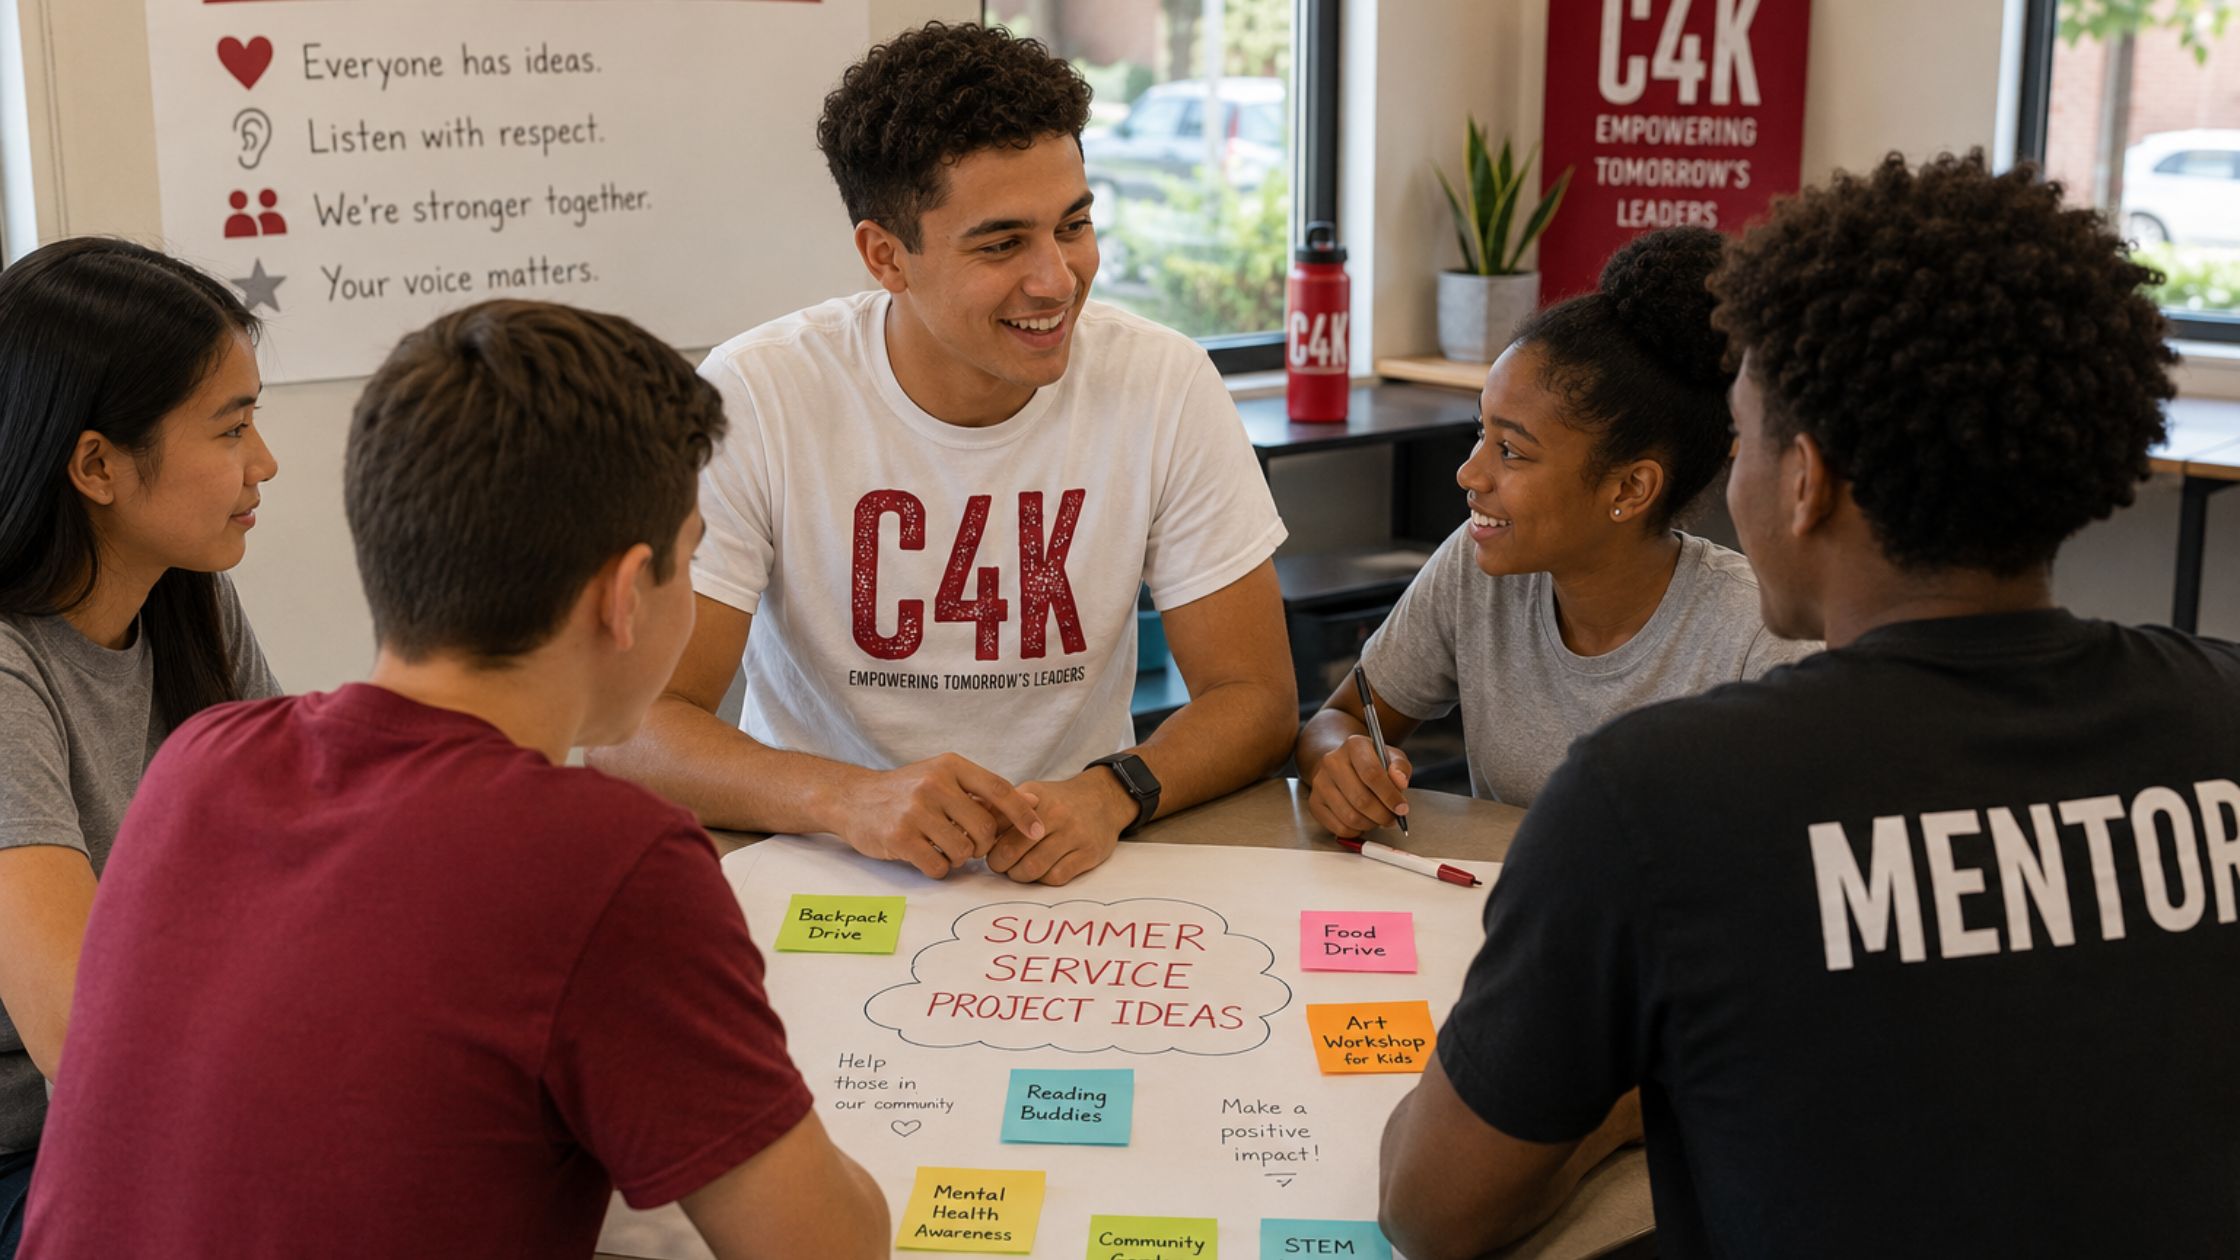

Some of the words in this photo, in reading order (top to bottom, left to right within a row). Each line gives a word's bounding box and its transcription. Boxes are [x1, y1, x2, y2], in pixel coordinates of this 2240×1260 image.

[1598, 0, 1761, 105] C4K
[303, 43, 444, 91] Everyone
[462, 43, 511, 75] has
[525, 42, 602, 74] ideas.
[308, 118, 406, 153] Listen
[421, 115, 484, 149] with
[499, 113, 605, 157] respect.
[1595, 114, 1757, 146] EMPOWERING
[1594, 156, 1751, 189] TOMORROW'S
[314, 192, 399, 227] We're
[413, 189, 532, 232] stronger
[547, 183, 652, 227] together.
[1616, 198, 1718, 230] LEADERS
[320, 265, 390, 301] Your
[403, 266, 473, 296] voice
[488, 256, 599, 291] matters.
[1289, 310, 1348, 368] C4K
[852, 488, 1087, 661] C4K
[849, 670, 939, 690] EMPOWERING
[944, 672, 1031, 691] TOMORROW'S
[1034, 666, 1086, 687] LEADERS
[1808, 779, 2240, 971] MENTOR
[798, 908, 888, 927] Backpack
[808, 927, 862, 940] Drive
[984, 916, 1206, 951] SUMMER
[1324, 924, 1376, 939] Food
[1324, 942, 1387, 957] Drive
[985, 954, 1194, 990] SERVICE
[927, 992, 1095, 1023] PROJECT
[1111, 1000, 1244, 1030] IDEAS
[1346, 1016, 1388, 1030] Art
[1323, 1035, 1426, 1051] Workshop
[838, 1052, 886, 1073] Help
[1344, 1052, 1369, 1065] for
[1377, 1052, 1413, 1065] Kids
[834, 1076, 889, 1090] those
[899, 1076, 917, 1090] in
[835, 1100, 866, 1110] our
[874, 1097, 954, 1114] community
[1027, 1084, 1107, 1109] Reading
[1221, 1098, 1282, 1115] Make
[1293, 1104, 1308, 1115] a
[1020, 1105, 1102, 1123] Buddies
[1221, 1124, 1311, 1145] positive
[1234, 1144, 1319, 1167] impact!
[933, 1184, 1006, 1201] Mental
[932, 1205, 999, 1221] Health
[914, 1224, 1012, 1242] Awareness
[1099, 1231, 1205, 1256] Community
[1285, 1238, 1355, 1254] STEM
